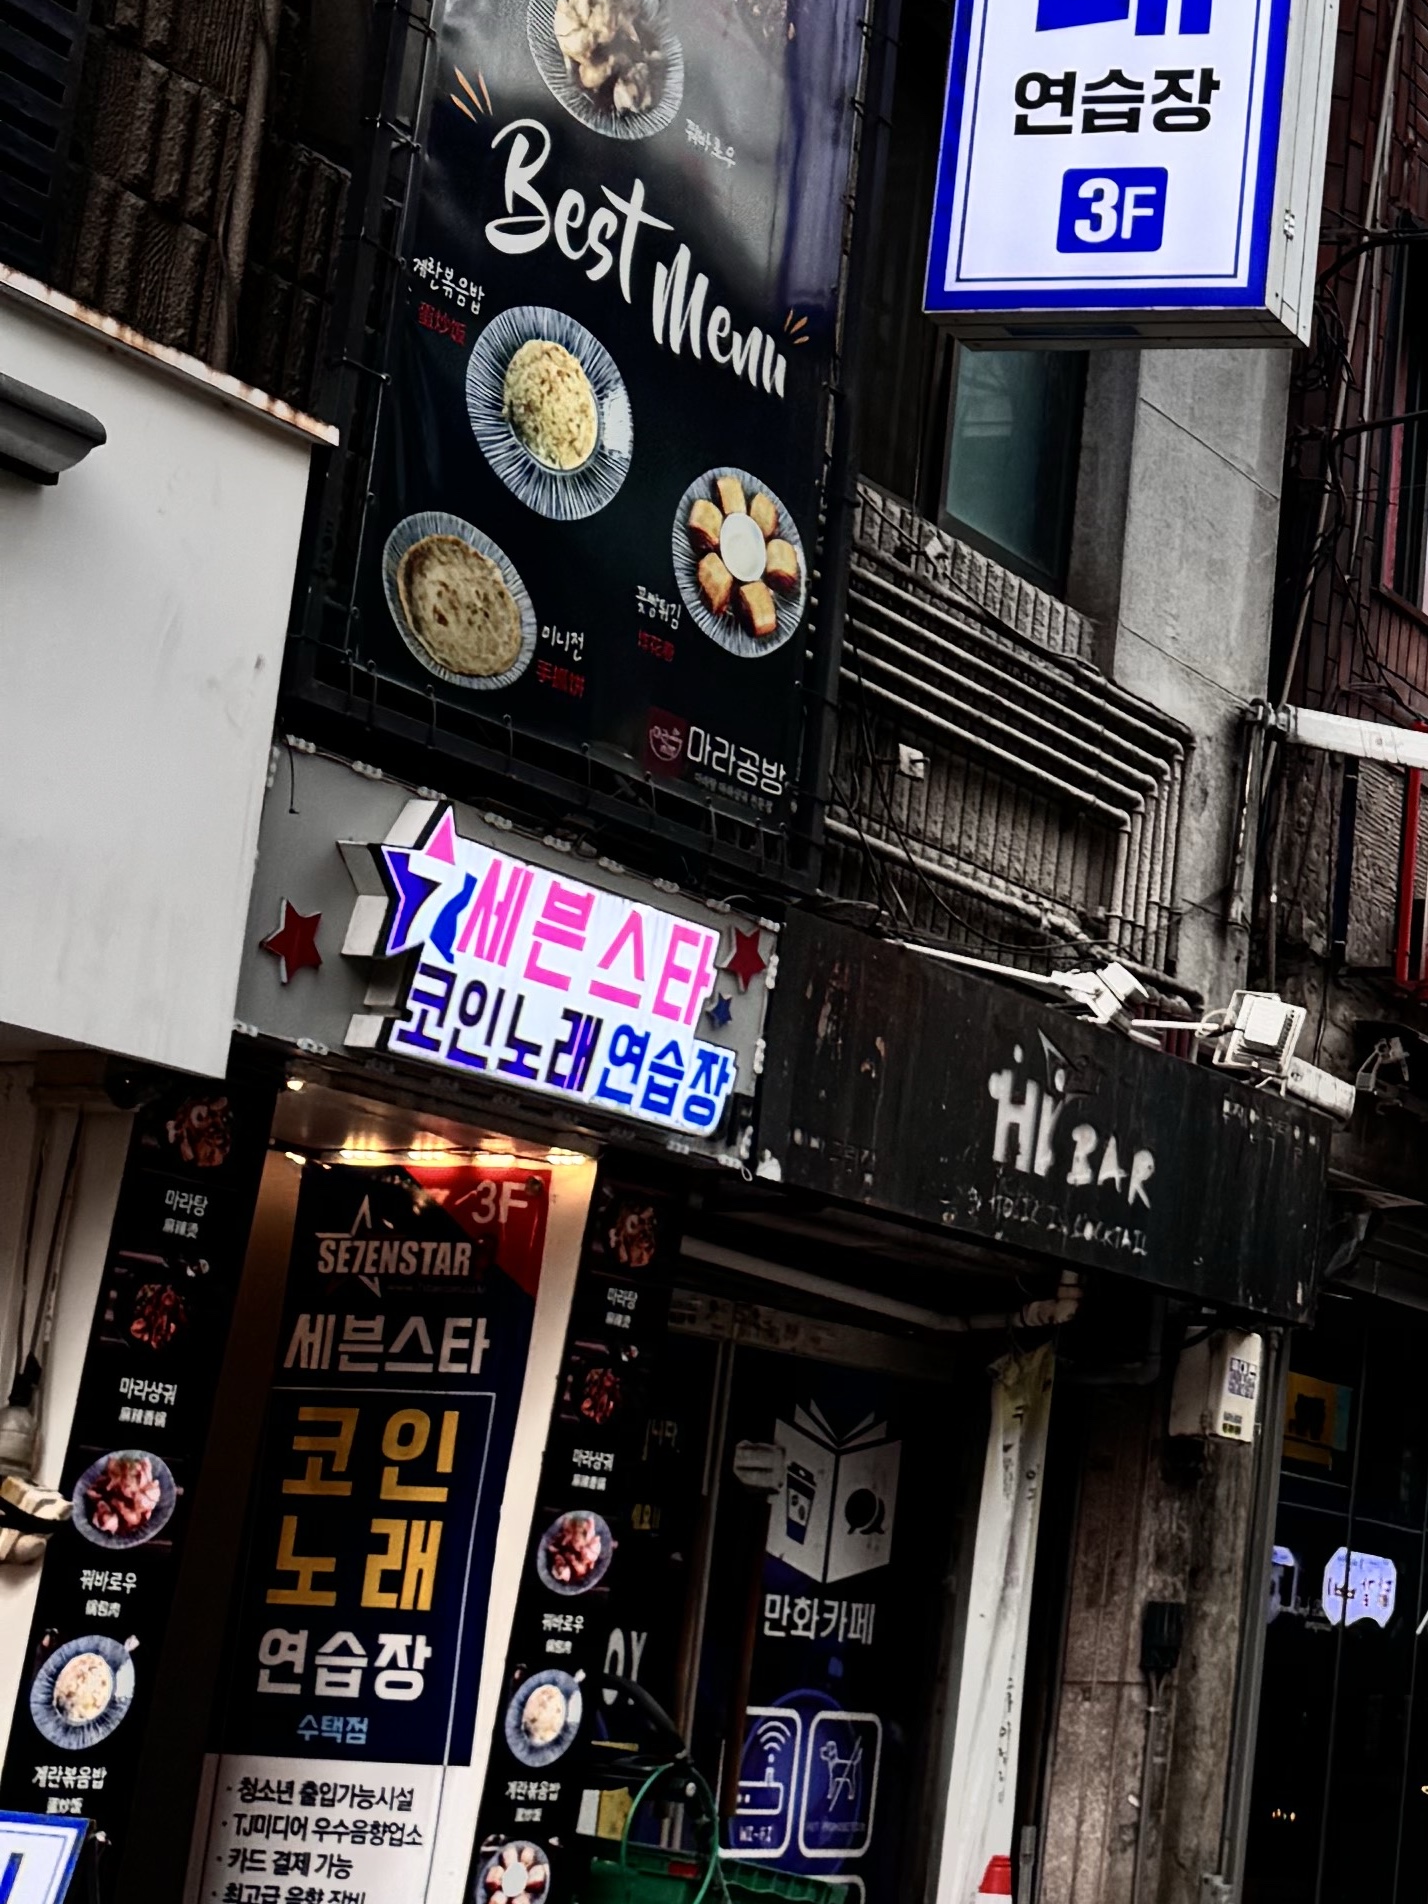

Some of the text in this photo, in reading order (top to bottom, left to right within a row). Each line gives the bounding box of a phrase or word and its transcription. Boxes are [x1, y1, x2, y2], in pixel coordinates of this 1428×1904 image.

[1013, 67, 1221, 138] 연습장
[484, 117, 674, 304] Best
[1074, 176, 1156, 245] 3F
[413, 256, 485, 315] 계란볶음밥
[652, 243, 789, 400] Menu
[541, 625, 584, 661] 미니전
[687, 726, 786, 795] 마라공방
[456, 857, 714, 1026] 세븐스타
[1066, 1123, 1154, 1209] BAR
[165, 1189, 209, 1217] 마라탕
[471, 1179, 529, 1223] 3F
[283, 1313, 490, 1374] 세븐스타
[119, 1377, 177, 1406] 마라샹궈
[763, 1594, 876, 1646] 만화카페
[257, 1628, 432, 1702] 연습장
[296, 1714, 368, 1745] 수택점
[32, 1765, 108, 1790] 계란볶음밥
[238, 1777, 414, 1812] 청소년 출입가능시설
[233, 1813, 423, 1848] TJ미디어 우수음향업소
[228, 1847, 354, 1880] 카드 결제 가능
